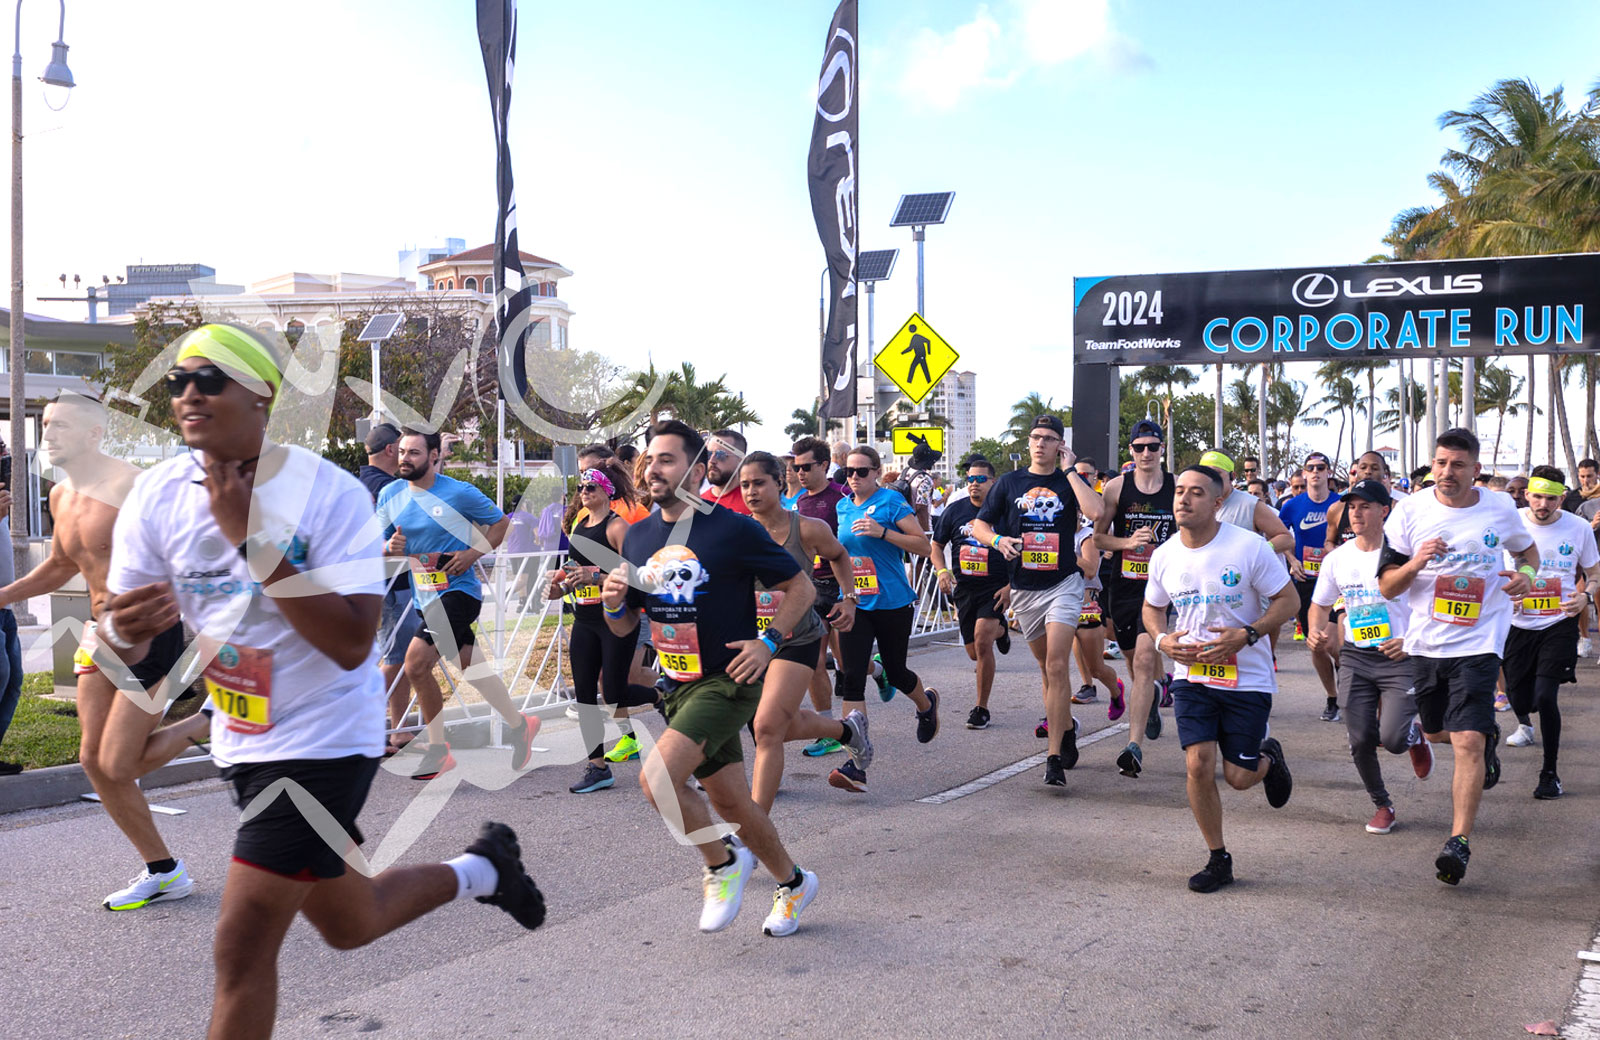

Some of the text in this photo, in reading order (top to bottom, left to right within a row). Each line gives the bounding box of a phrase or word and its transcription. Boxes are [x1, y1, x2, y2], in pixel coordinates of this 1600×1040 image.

[1343, 274, 1483, 298] LEXUS
[1103, 290, 1164, 326] 2024
[1202, 304, 1584, 354] CORPORATE RUN
[1085, 338, 1182, 350] TeamFootWorks
[1030, 552, 1049, 563] 383
[966, 562, 980, 570] 387
[1130, 562, 1148, 573] 200
[1310, 562, 1323, 571] 19
[420, 573, 438, 585] 282
[1225, 594, 1242, 603] RUN
[1532, 598, 1550, 609] 171
[1447, 601, 1471, 616] 167
[1360, 626, 1381, 640] 580
[664, 654, 688, 671] 356
[1201, 664, 1225, 677] 168
[216, 688, 249, 719] 170
